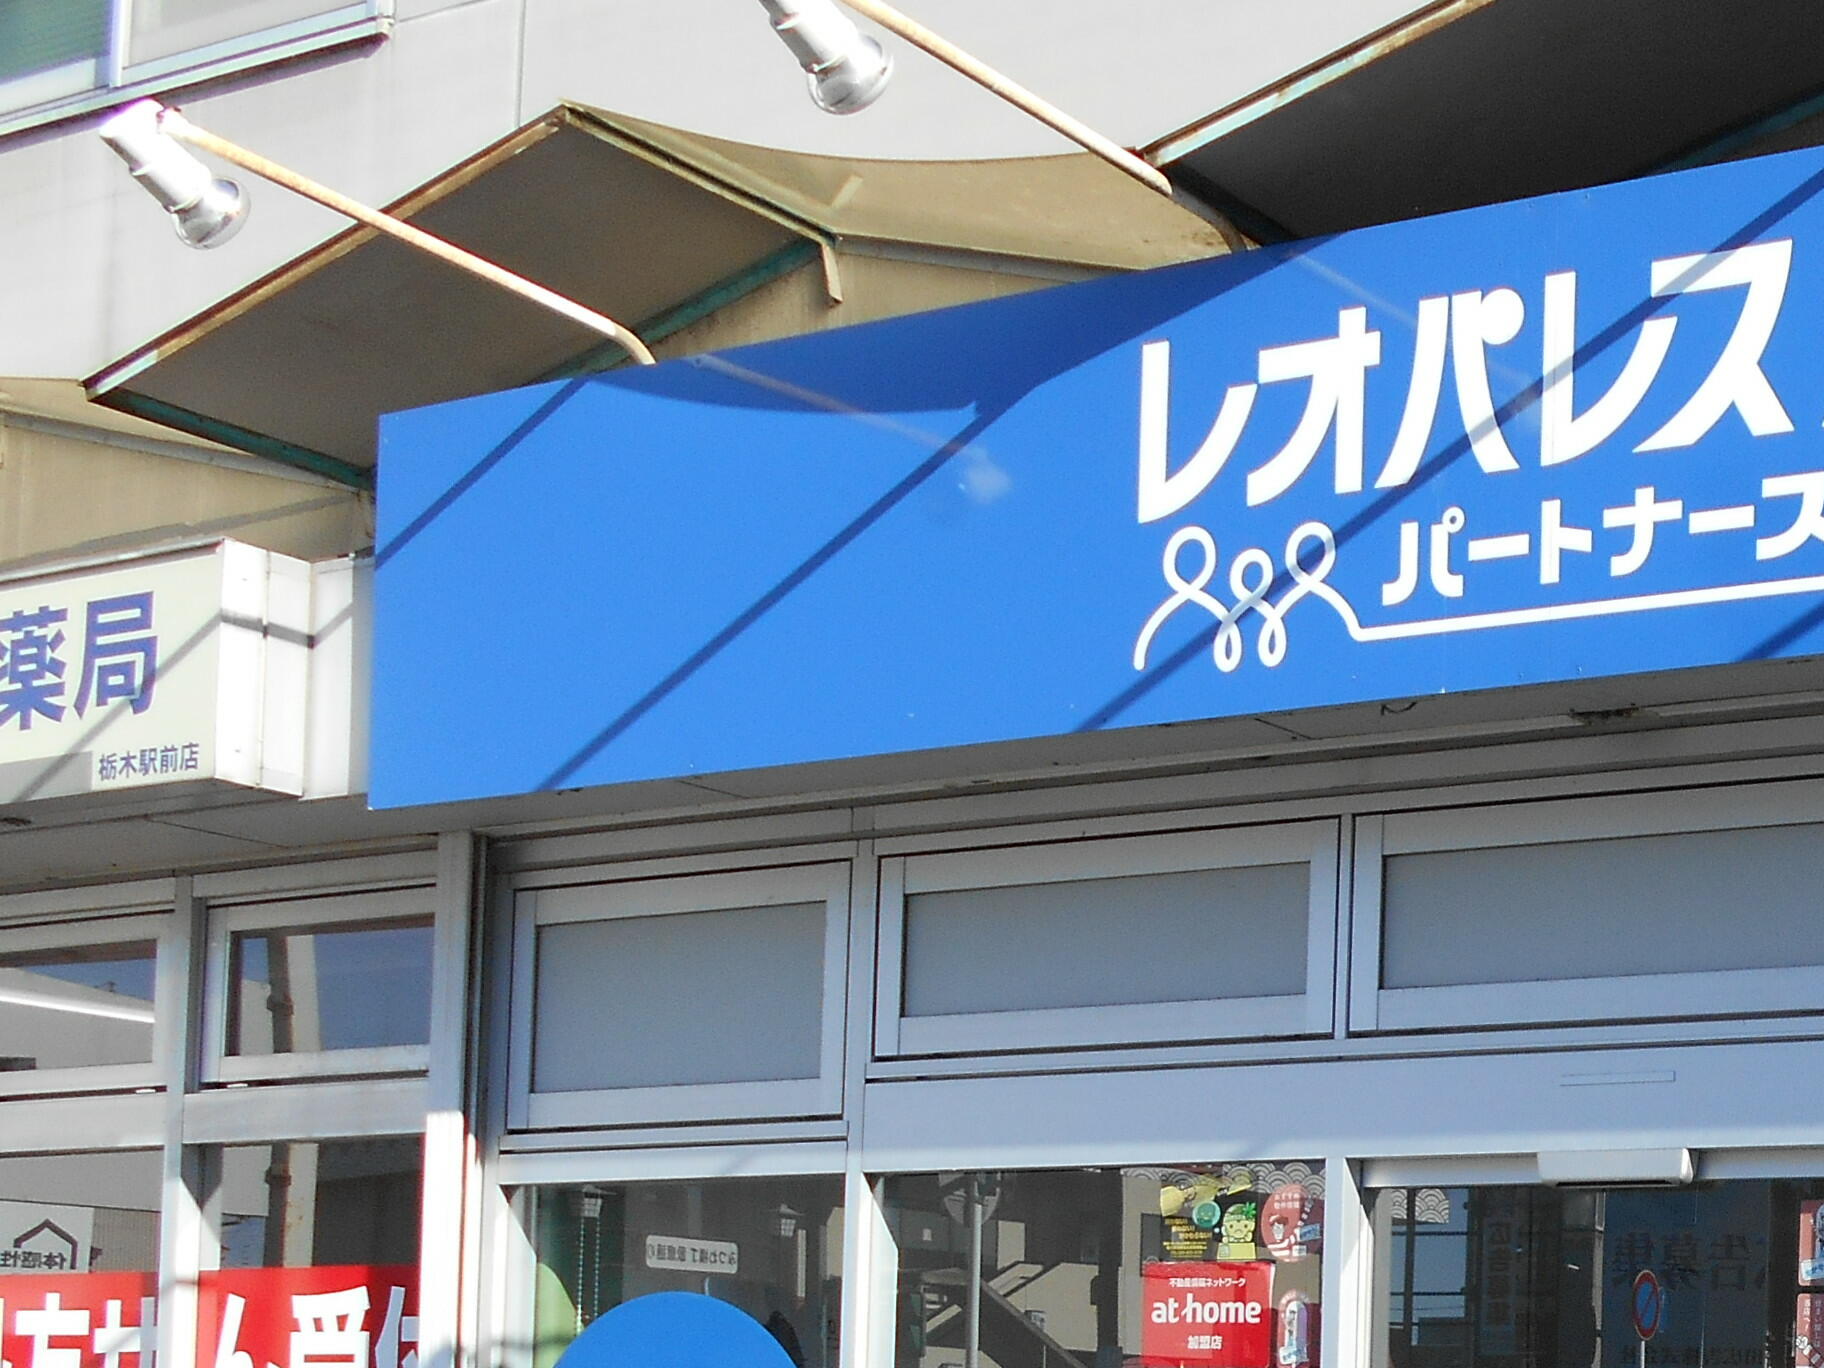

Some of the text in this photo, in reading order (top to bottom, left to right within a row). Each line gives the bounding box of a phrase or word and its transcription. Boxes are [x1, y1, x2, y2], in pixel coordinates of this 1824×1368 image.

[0, 591, 158, 731] 薬局
[98, 742, 200, 781] 栃木駅前店
[1151, 1298, 1179, 1323] at
[1181, 1293, 1262, 1324] home
